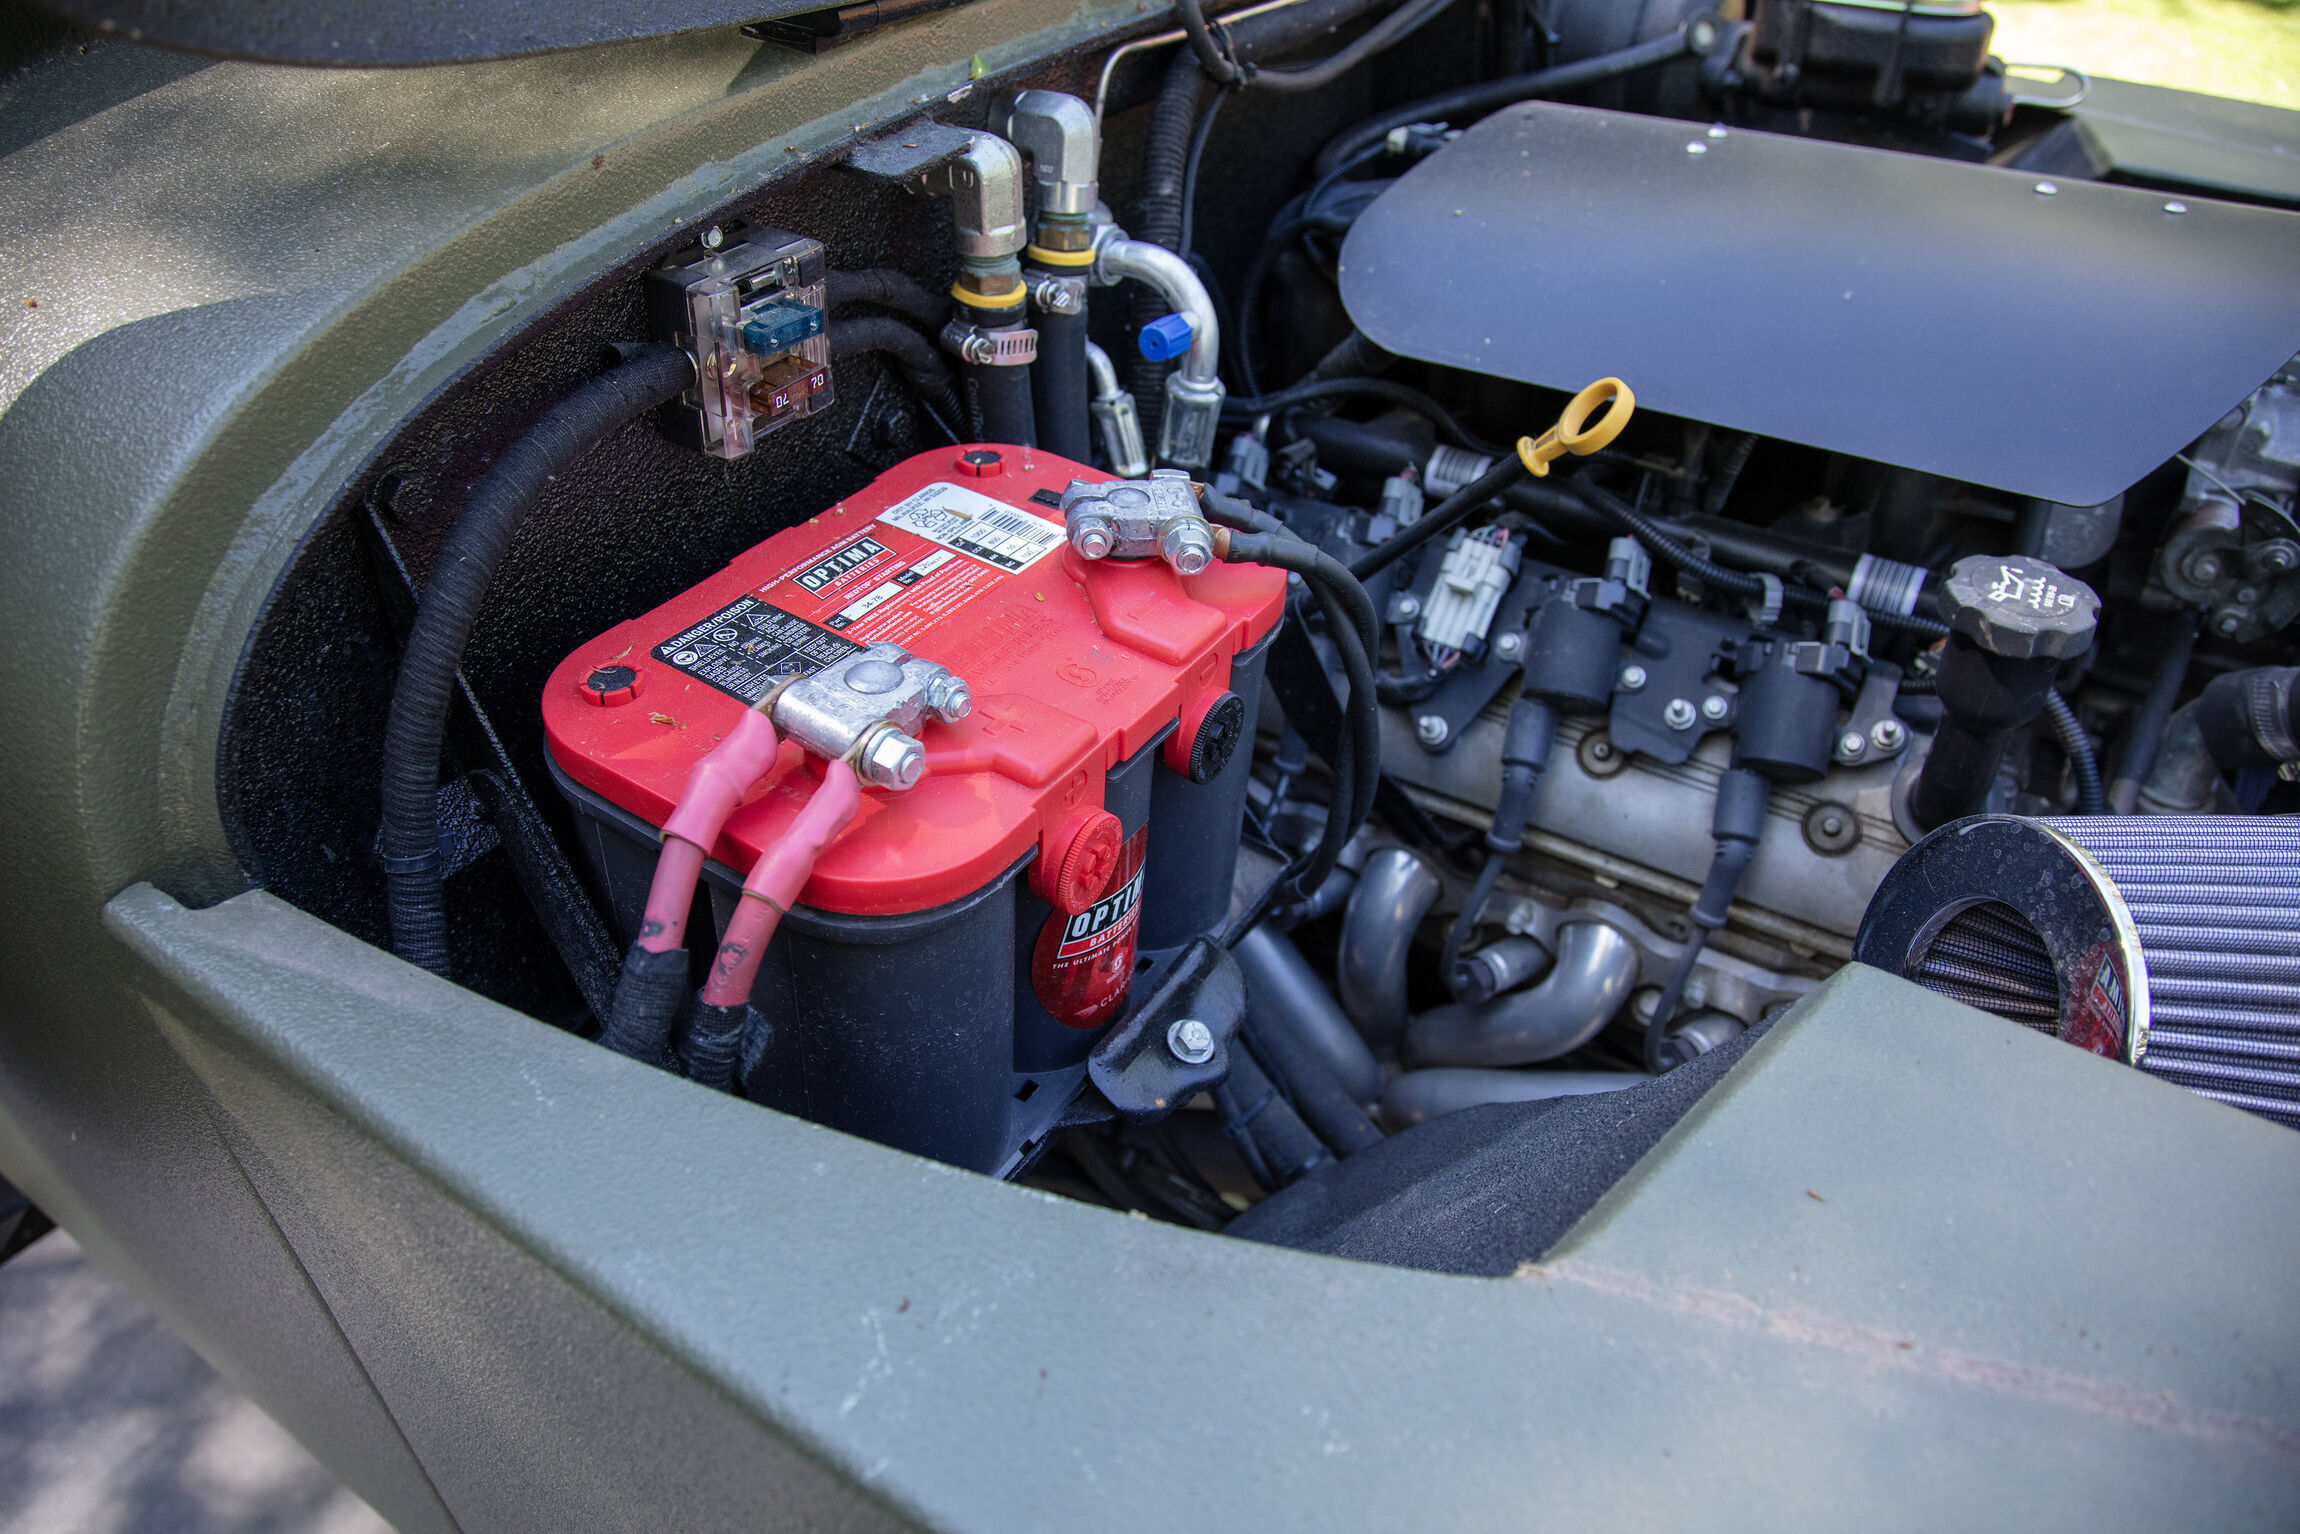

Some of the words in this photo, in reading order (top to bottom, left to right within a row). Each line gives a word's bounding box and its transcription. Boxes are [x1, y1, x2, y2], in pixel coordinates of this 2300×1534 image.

[810, 373, 824, 389] 70
[775, 392, 790, 409] 70
[970, 528, 987, 538] 1000
[759, 548, 832, 593] HIGH-PERFORMANCE
[846, 523, 877, 543] BATTERY
[802, 541, 881, 588] OPTIMA
[834, 558, 880, 587] BATTERIES
[873, 560, 907, 582] STARTING
[862, 612, 880, 623] FREE
[877, 592, 913, 614] Replacement
[920, 576, 936, 585] Proof
[669, 597, 755, 648] DANGER/POISON
[757, 613, 786, 630] SULFURIC
[765, 624, 781, 633] ACID
[778, 623, 807, 640] BLINDNESS
[793, 626, 813, 638] SEVERE
[858, 628, 880, 641] Register
[758, 643, 783, 657] SMOKING
[802, 643, 820, 653] KEEP
[817, 647, 837, 659] REACH
[688, 657, 712, 671] SHIELD
[698, 655, 732, 676] EXPLOSIVE
[705, 665, 728, 679] GASES
[719, 668, 750, 686] BLINDNESS
[736, 681, 759, 695] FLUSH
[1071, 867, 1145, 938] OPTIM
[1051, 962, 1069, 970] THE
[1073, 946, 1110, 967] ULTIMATE
[1112, 926, 1132, 947] POWER
